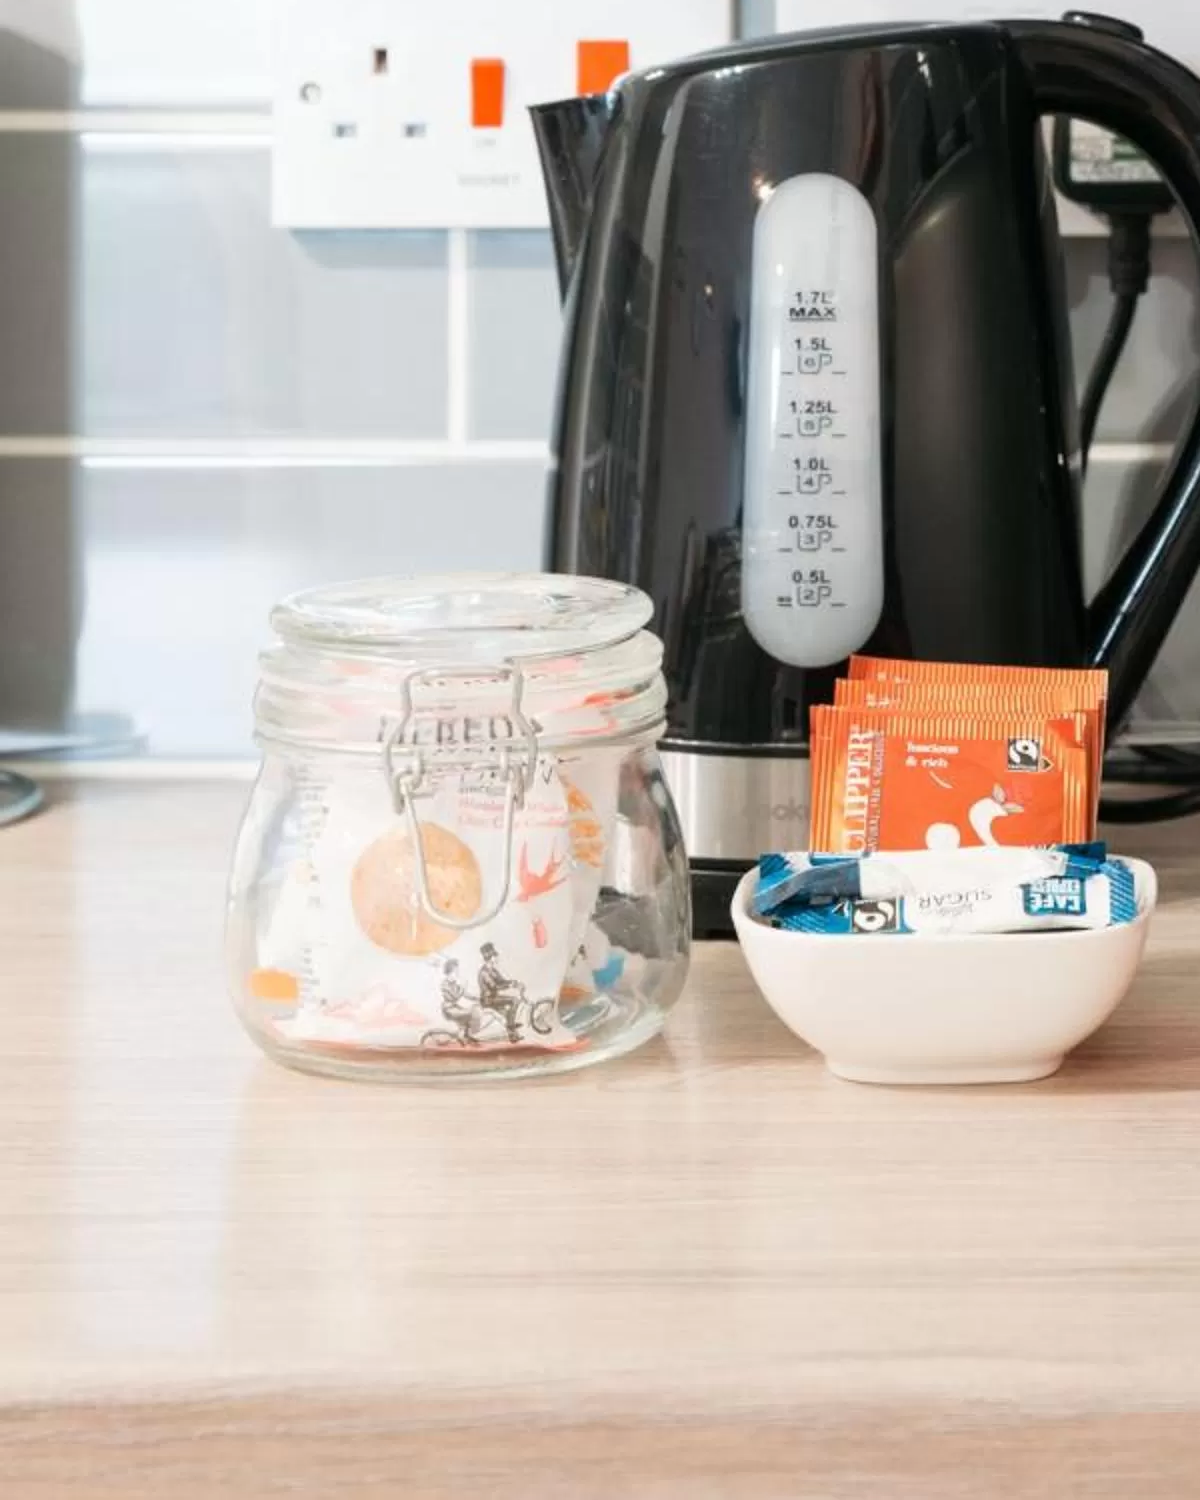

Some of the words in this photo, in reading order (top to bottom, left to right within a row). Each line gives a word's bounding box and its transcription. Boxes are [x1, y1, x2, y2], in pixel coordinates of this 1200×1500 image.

[794, 291, 833, 305] 1.7L
[789, 307, 837, 318] MAX
[794, 338, 833, 351] 1.5L
[789, 401, 838, 414] 1.25L
[793, 457, 831, 471] 1.0L
[788, 515, 838, 529] 0.75L
[791, 570, 832, 584] 0.5L
[843, 731, 874, 852] CLIPPER
